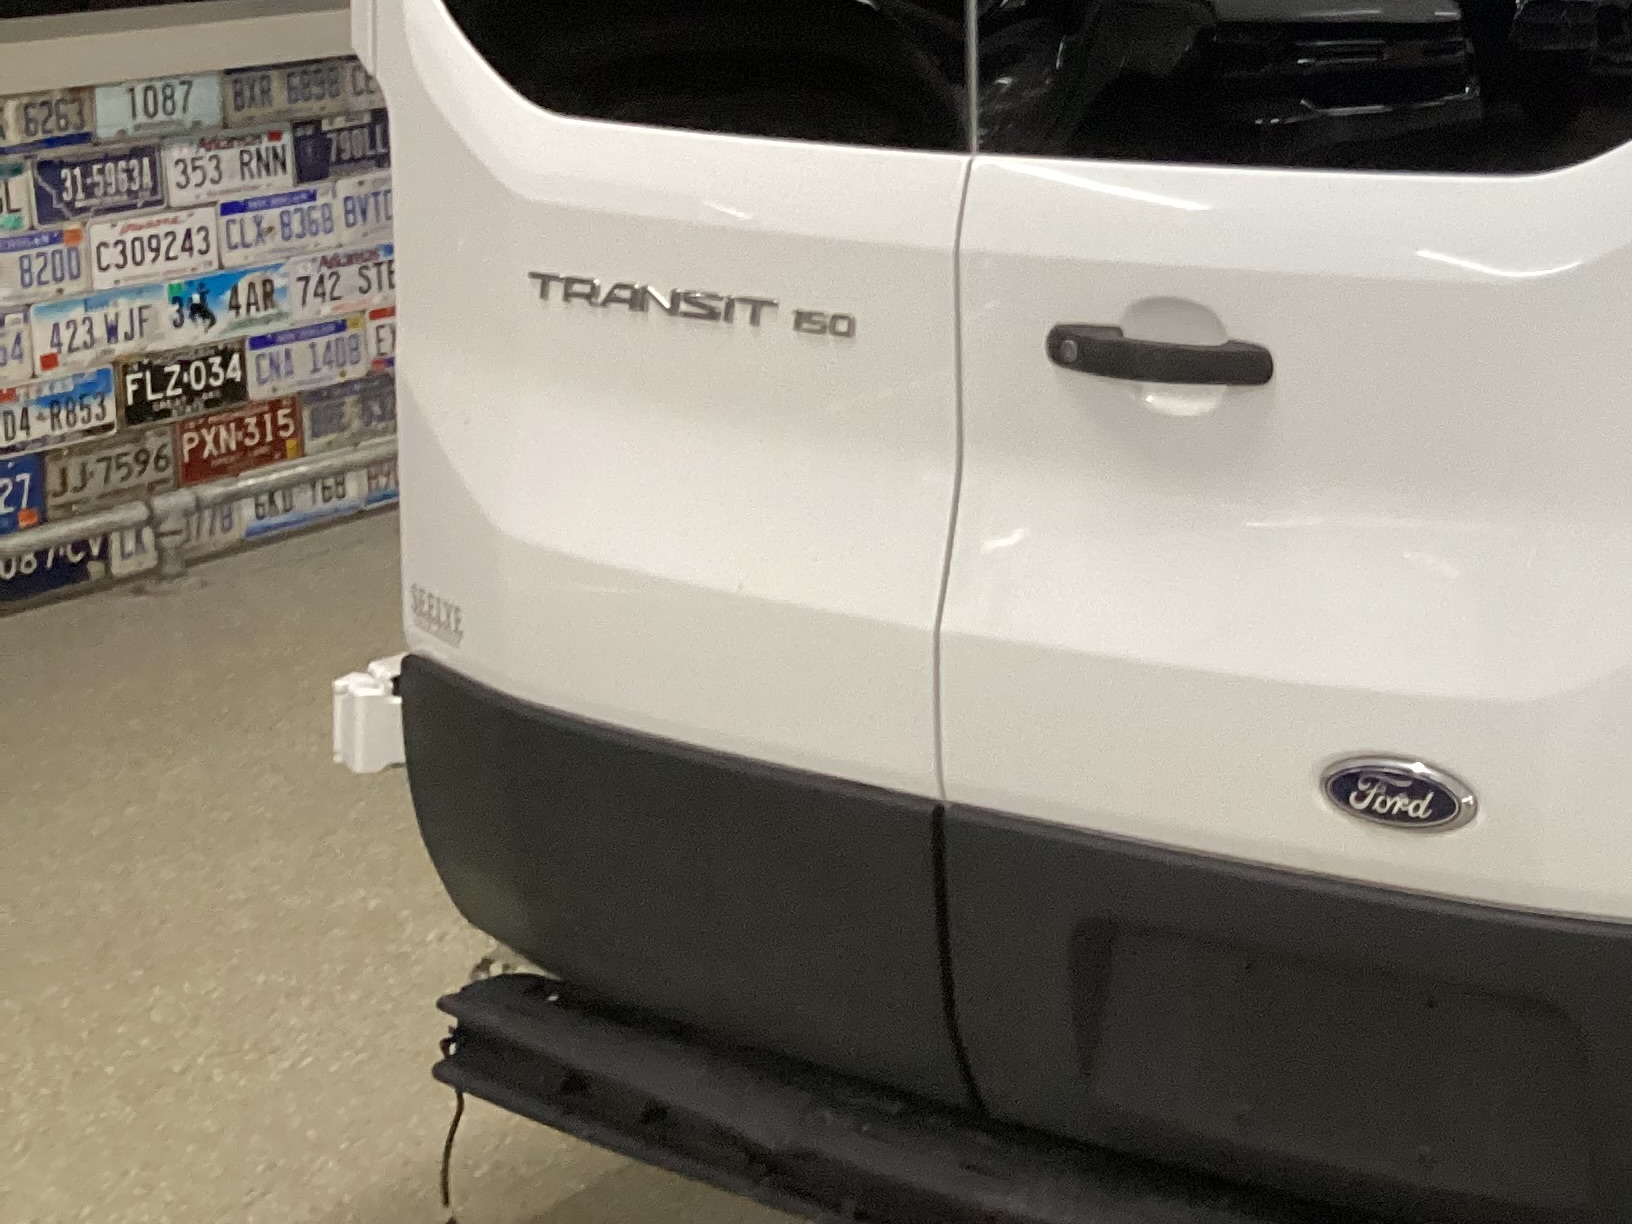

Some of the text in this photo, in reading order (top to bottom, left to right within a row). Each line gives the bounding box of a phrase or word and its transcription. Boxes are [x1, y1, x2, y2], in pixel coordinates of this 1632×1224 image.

[126, 79, 194, 120] 1087
[173, 154, 223, 190] 353
[239, 142, 288, 182] RNN
[96, 225, 212, 273] C309243
[225, 214, 268, 251] CLX
[19, 245, 82, 289] 8200
[296, 270, 342, 309] 742
[228, 278, 277, 318] 4AR
[527, 271, 857, 339] TRANSIT 150
[50, 315, 97, 355] 423
[104, 304, 153, 345] WJF
[1349, 775, 1433, 821] Ford
